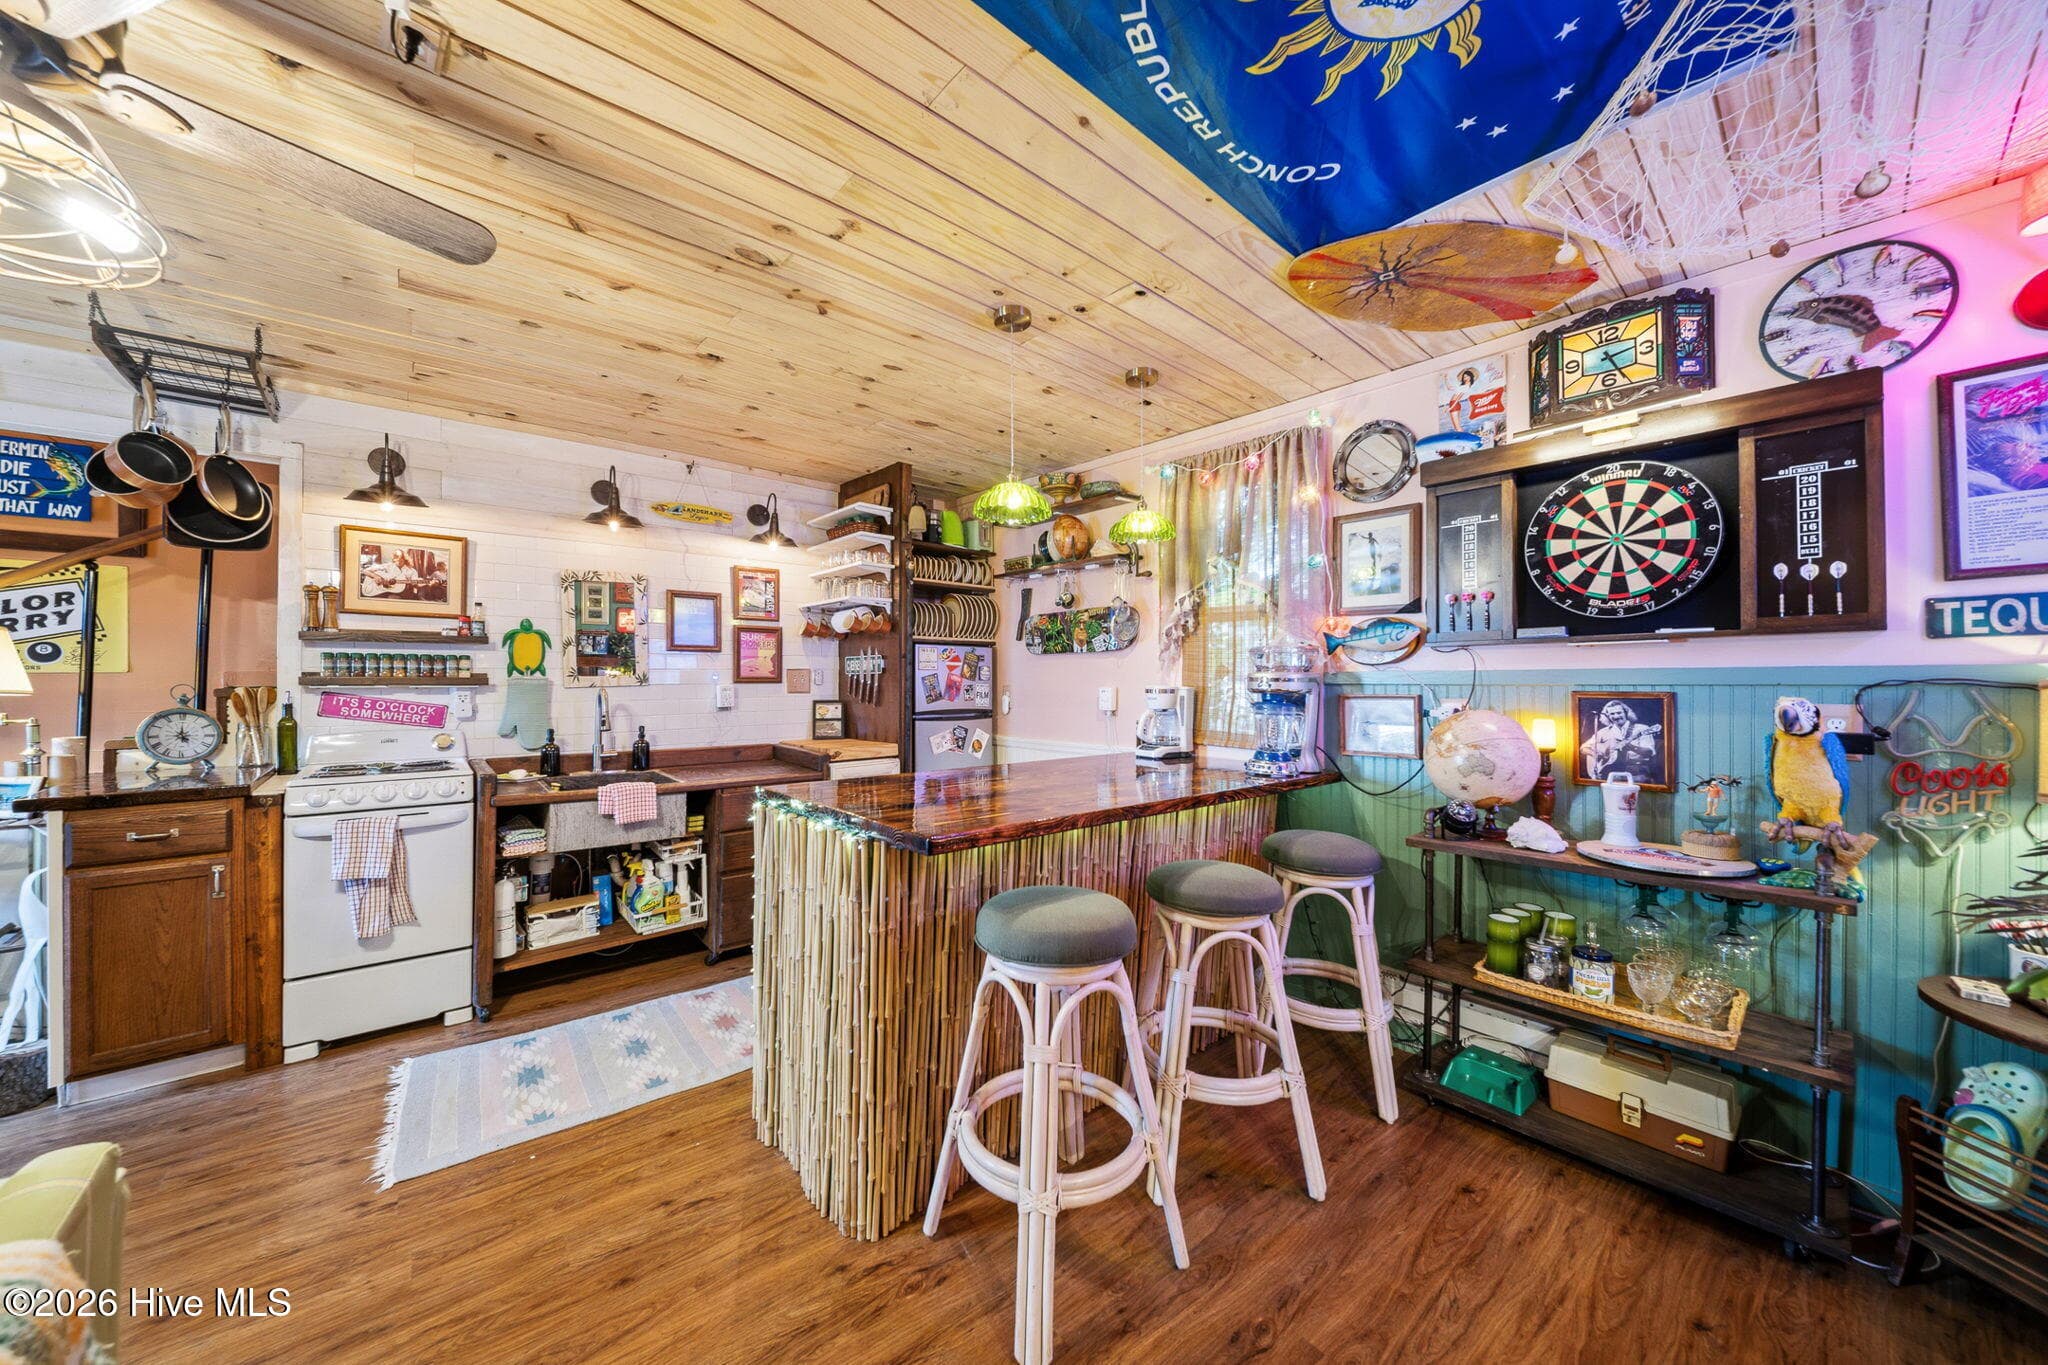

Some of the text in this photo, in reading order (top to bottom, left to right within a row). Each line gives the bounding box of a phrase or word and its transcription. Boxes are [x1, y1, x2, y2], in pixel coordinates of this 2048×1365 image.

[1217, 142, 1341, 183] CONCH
[1597, 326, 1620, 344] 12
[1639, 340, 1654, 355] 3
[1565, 360, 1580, 374] 9
[1601, 373, 1617, 387] 6
[0, 440, 50, 459] ERMEN
[0, 460, 32, 477] DIE
[1606, 463, 1620, 474] 20
[1664, 466, 1677, 477] 18
[1801, 475, 1817, 484] 20
[1801, 487, 1817, 495] 19
[0, 497, 83, 518] THAT WAY
[1802, 499, 1817, 508] 18
[1802, 511, 1817, 520] 17
[1802, 523, 1817, 532] 16
[1802, 535, 1818, 544] 15
[1, 591, 76, 615] LOR
[1616, 608, 1624, 617] 3
[332, 696, 437, 716] IT'S 5 O'CLOCK
[340, 706, 430, 724] SOMEWHERE
[1900, 789, 2005, 817] LIGHT
